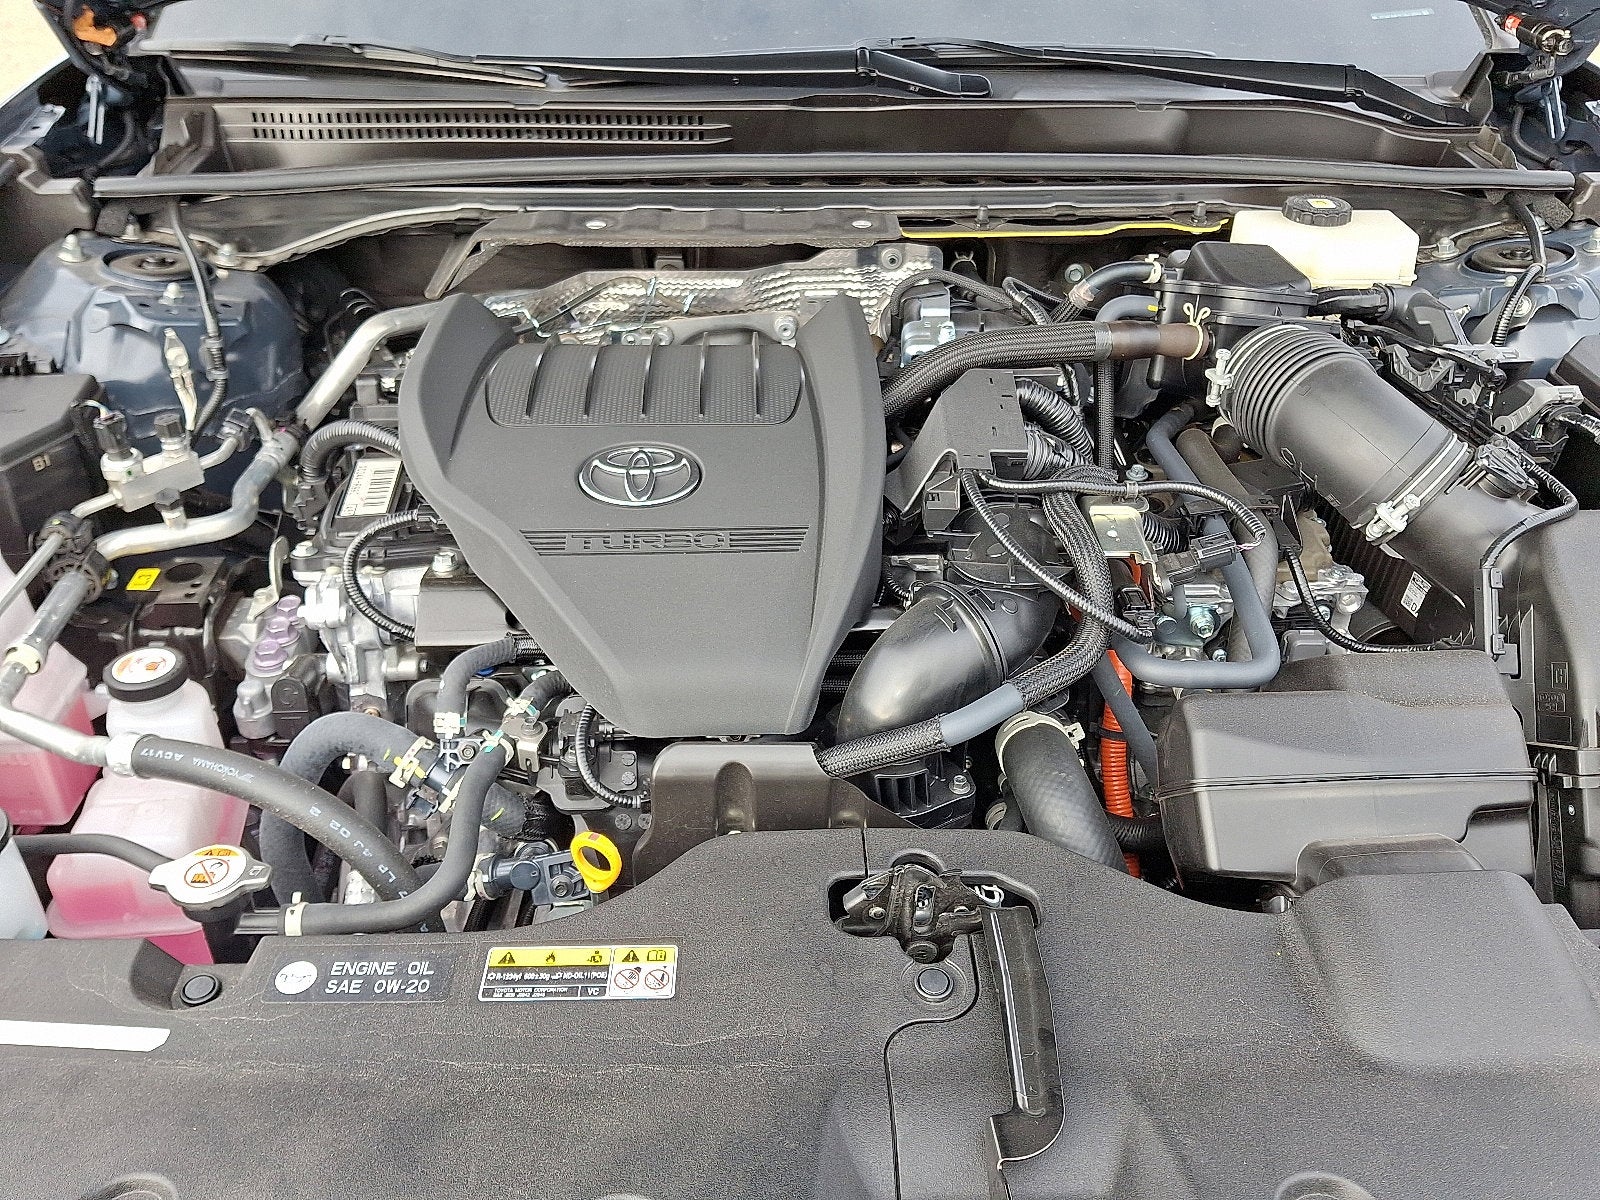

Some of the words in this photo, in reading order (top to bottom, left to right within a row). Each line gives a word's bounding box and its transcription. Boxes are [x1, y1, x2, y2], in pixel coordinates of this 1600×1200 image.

[571, 532, 725, 550] TURBO
[140, 748, 185, 760] ACV17
[192, 757, 241, 780] YOKOHAMA
[330, 961, 397, 976] ENGINE
[407, 961, 435, 975] OIL
[325, 979, 363, 994] SAE
[373, 979, 430, 994] 0W-20
[587, 988, 600, 996] VC
